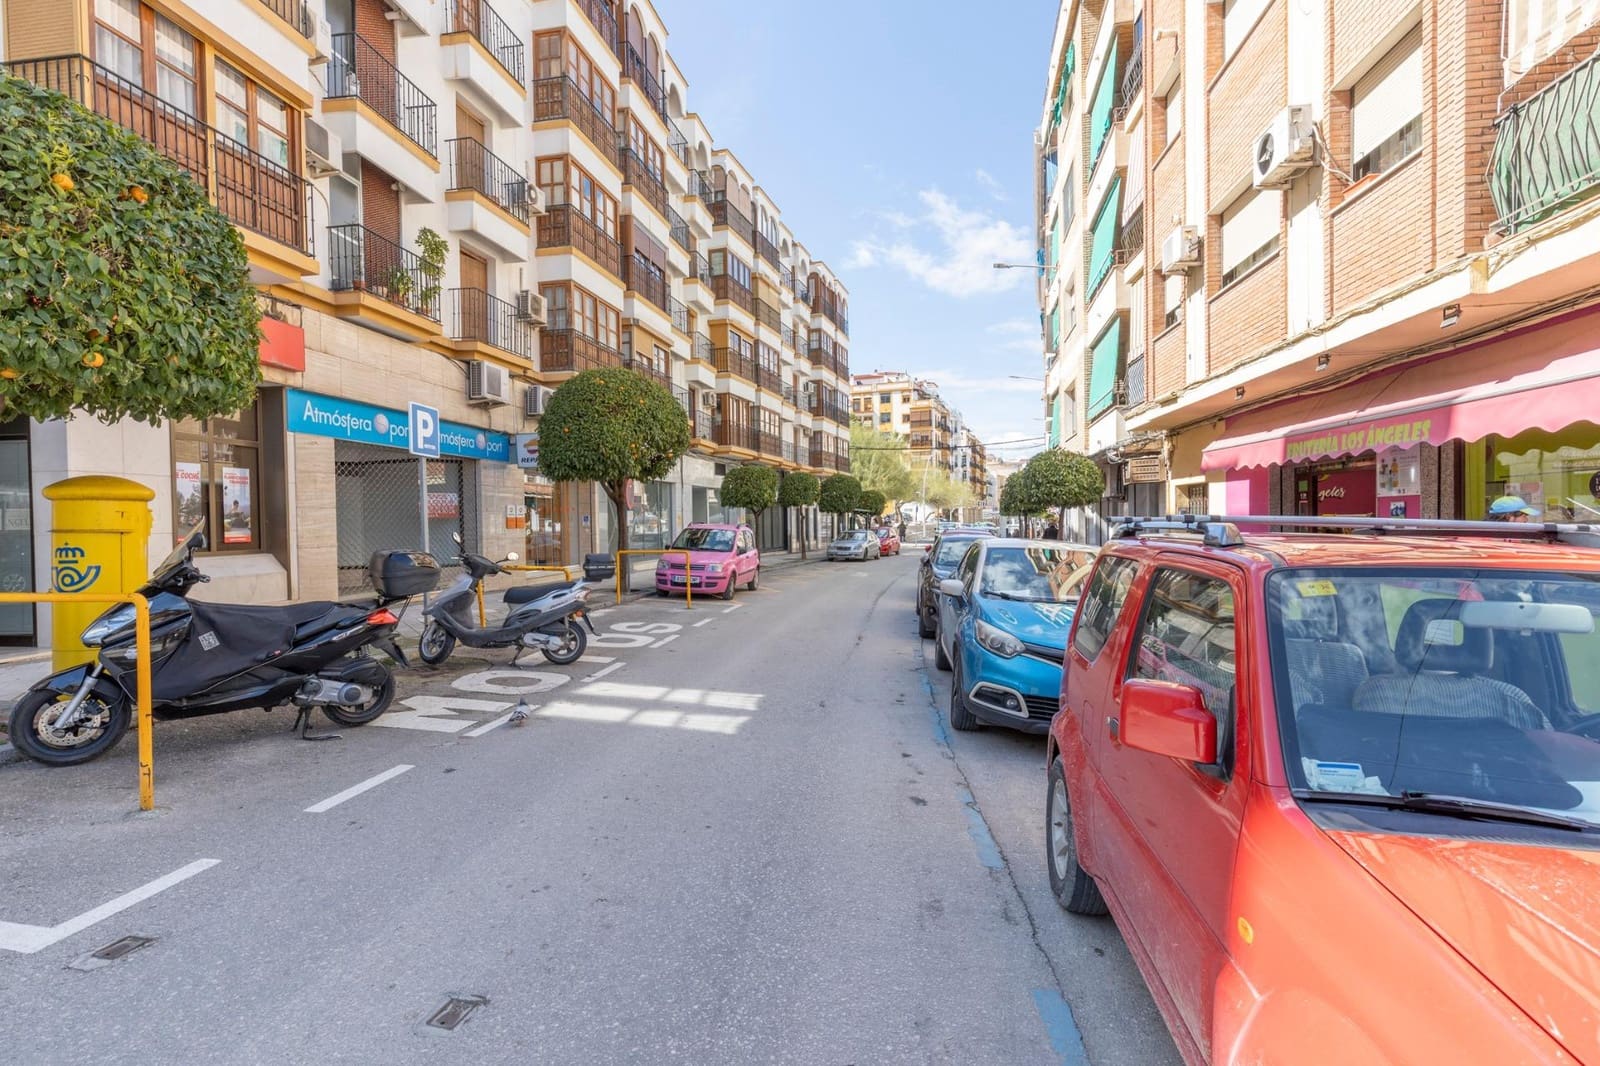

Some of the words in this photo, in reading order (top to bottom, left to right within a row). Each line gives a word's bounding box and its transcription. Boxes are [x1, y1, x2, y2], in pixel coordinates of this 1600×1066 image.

[303, 400, 372, 436] Atmósfera
[390, 423, 409, 443] por
[416, 409, 434, 449] P
[1341, 430, 1365, 450] LOS
[1367, 420, 1431, 446] ÁNGELES
[440, 431, 475, 453] mósfera
[1318, 486, 1345, 501] geles
